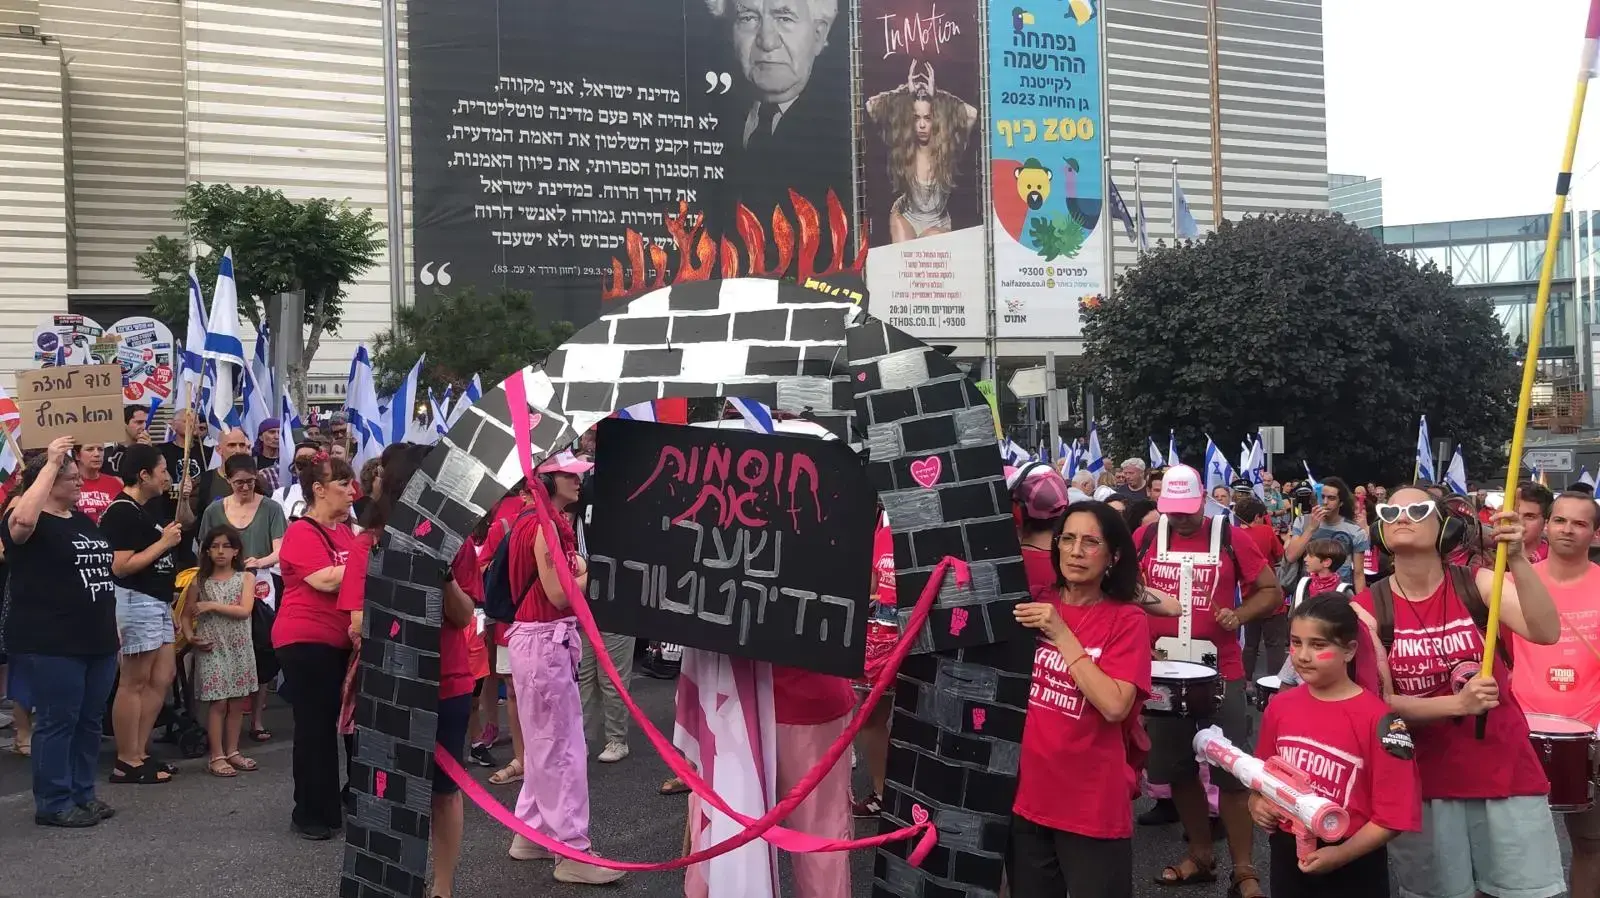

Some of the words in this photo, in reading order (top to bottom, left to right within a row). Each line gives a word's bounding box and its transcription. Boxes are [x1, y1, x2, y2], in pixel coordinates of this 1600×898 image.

[1013, 30, 1077, 52] נפתחה
[1003, 50, 1086, 74] ההרשמה
[494, 76, 545, 95] מקווה,
[549, 79, 574, 95] אני
[579, 77, 633, 99] ישראל,
[1020, 75, 1072, 94] לקייטנת
[636, 86, 680, 103] מדינת
[1001, 91, 1036, 106] 2023
[1038, 94, 1076, 109] החיות
[452, 98, 544, 119] טוטליטרית,
[549, 105, 594, 122] מדינה
[1078, 98, 1090, 112] גן
[598, 108, 628, 125] פעם
[632, 110, 653, 128] אף
[657, 112, 694, 129] תהיה
[698, 112, 719, 130] לא
[446, 125, 514, 143] המדעית,
[518, 129, 563, 145] האמת
[996, 118, 1037, 147] כיף
[1043, 116, 1094, 142] ZOO
[567, 132, 591, 147] את
[594, 131, 650, 151] השלטון
[654, 137, 689, 155] יקבע
[693, 139, 724, 155] שבה
[447, 151, 513, 169] האמנות,
[517, 154, 553, 172] כיוון
[557, 156, 580, 172] את
[585, 158, 650, 176] הספרותי,
[654, 162, 699, 179] הסגנון
[703, 165, 724, 179] את
[479, 174, 533, 195] ישראל
[537, 180, 593, 198] במדינת
[598, 184, 639, 200] הרוח.
[643, 186, 672, 204] דרך
[675, 188, 697, 203] את
[474, 204, 513, 220] הרוח
[518, 203, 567, 222] לאנשי
[572, 208, 616, 224] גמורה
[620, 210, 663, 226] חירות
[491, 231, 543, 248] ישעבד
[547, 229, 575, 247] ולא
[580, 233, 625, 249] יכבוש
[1056, 266, 1088, 277] לפרטים
[1001, 279, 1046, 288] haifazoo.co.il
[889, 304, 908, 315] 20:30
[912, 305, 931, 315] חיפה
[1003, 313, 1027, 323] אתוס
[32, 370, 80, 393] לחיצה
[83, 372, 112, 389] עוד
[35, 400, 78, 428] בחוץ
[82, 405, 113, 423] והוא
[626, 444, 820, 503] חוסמות
[671, 484, 768, 530] את
[71, 533, 109, 550] שלום
[89, 580, 114, 603] צדק
[1041, 688, 1078, 711] החזית
